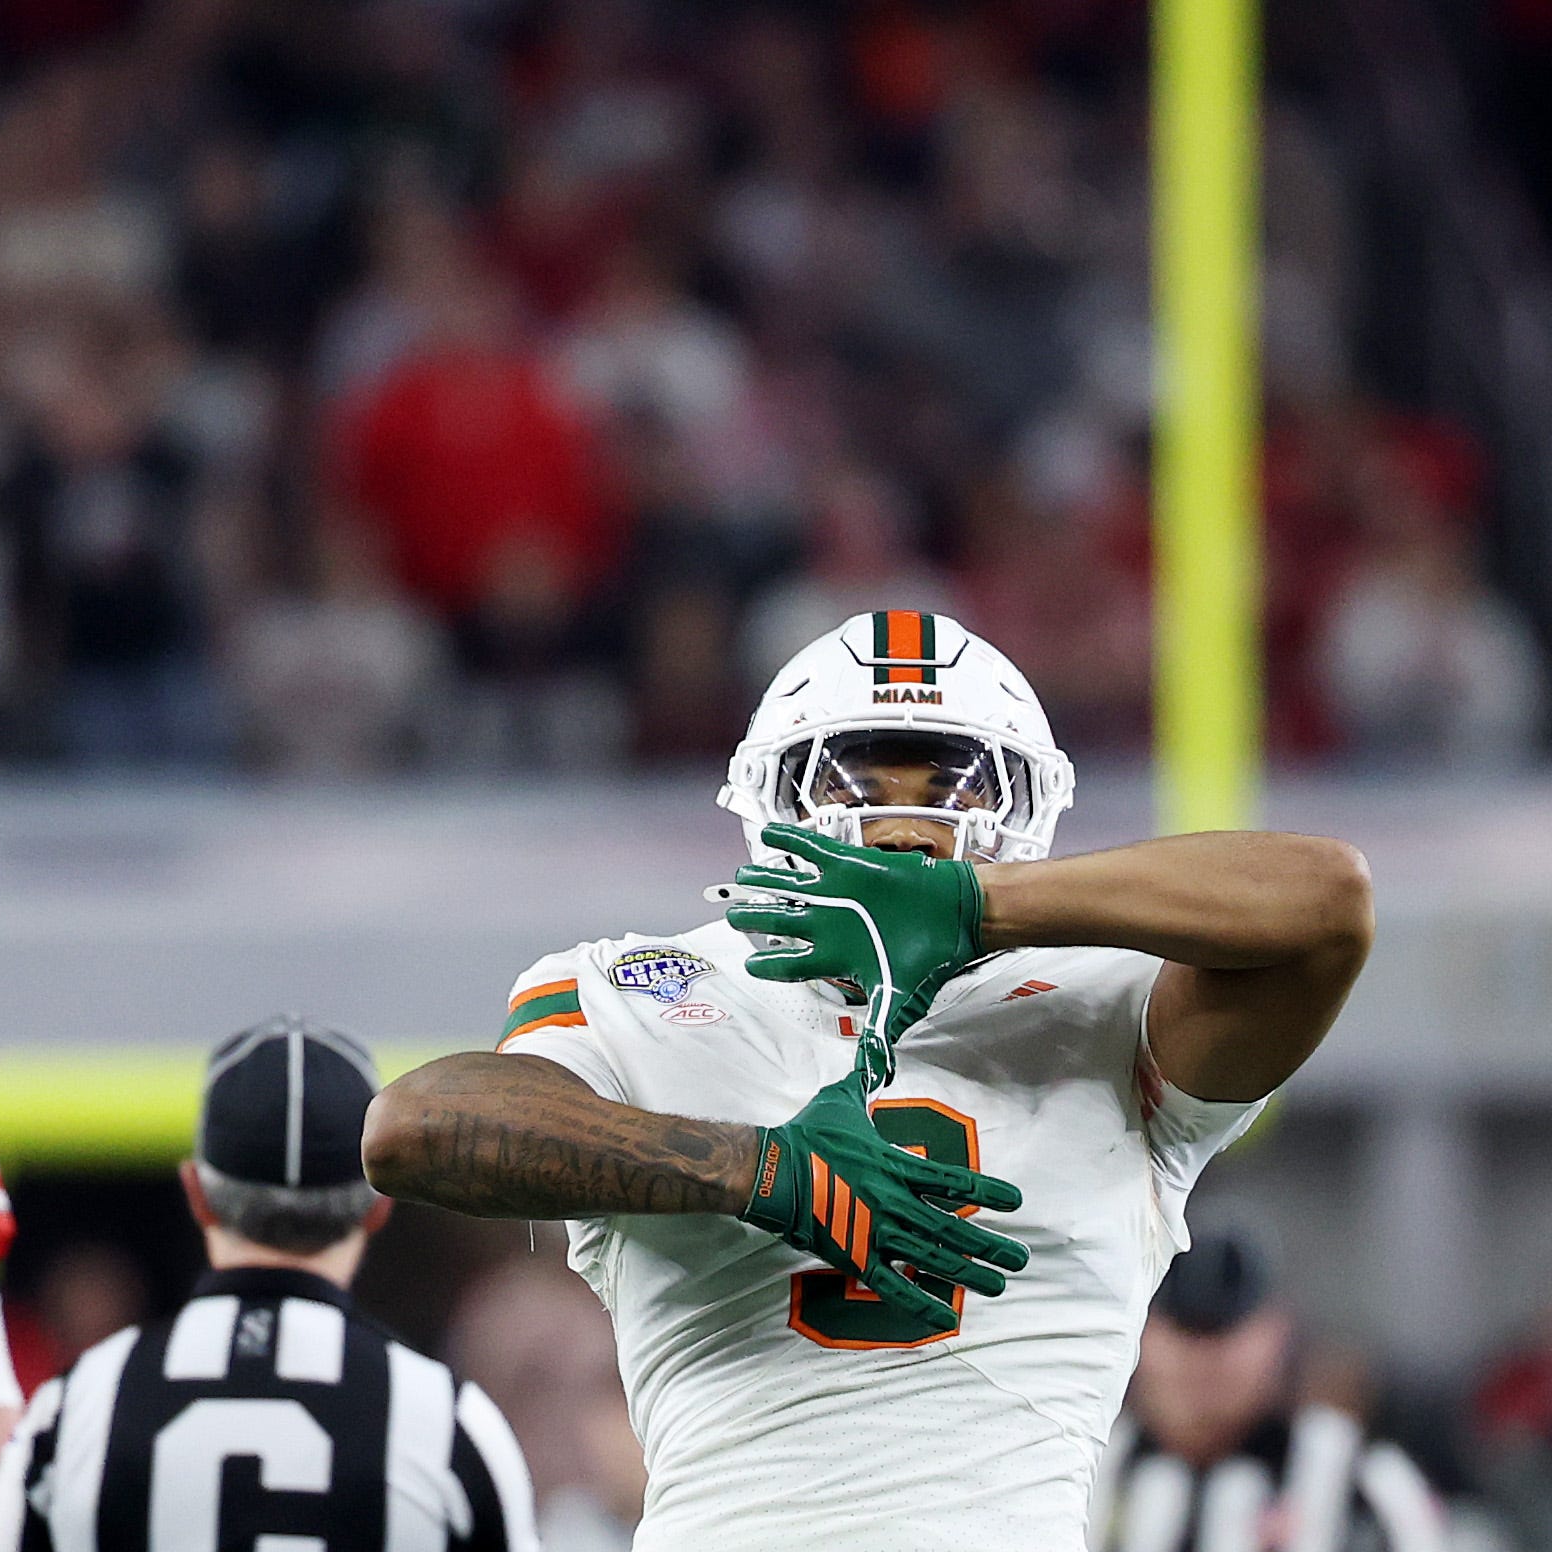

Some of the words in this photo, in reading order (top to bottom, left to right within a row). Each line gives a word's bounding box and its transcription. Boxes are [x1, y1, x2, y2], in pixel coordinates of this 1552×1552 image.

[873, 688, 943, 705] MIAMI
[615, 957, 712, 985] COTTON
[635, 964, 695, 986] BOWL
[670, 1008, 715, 1019] ACC
[758, 1139, 781, 1198] ADIZERO
